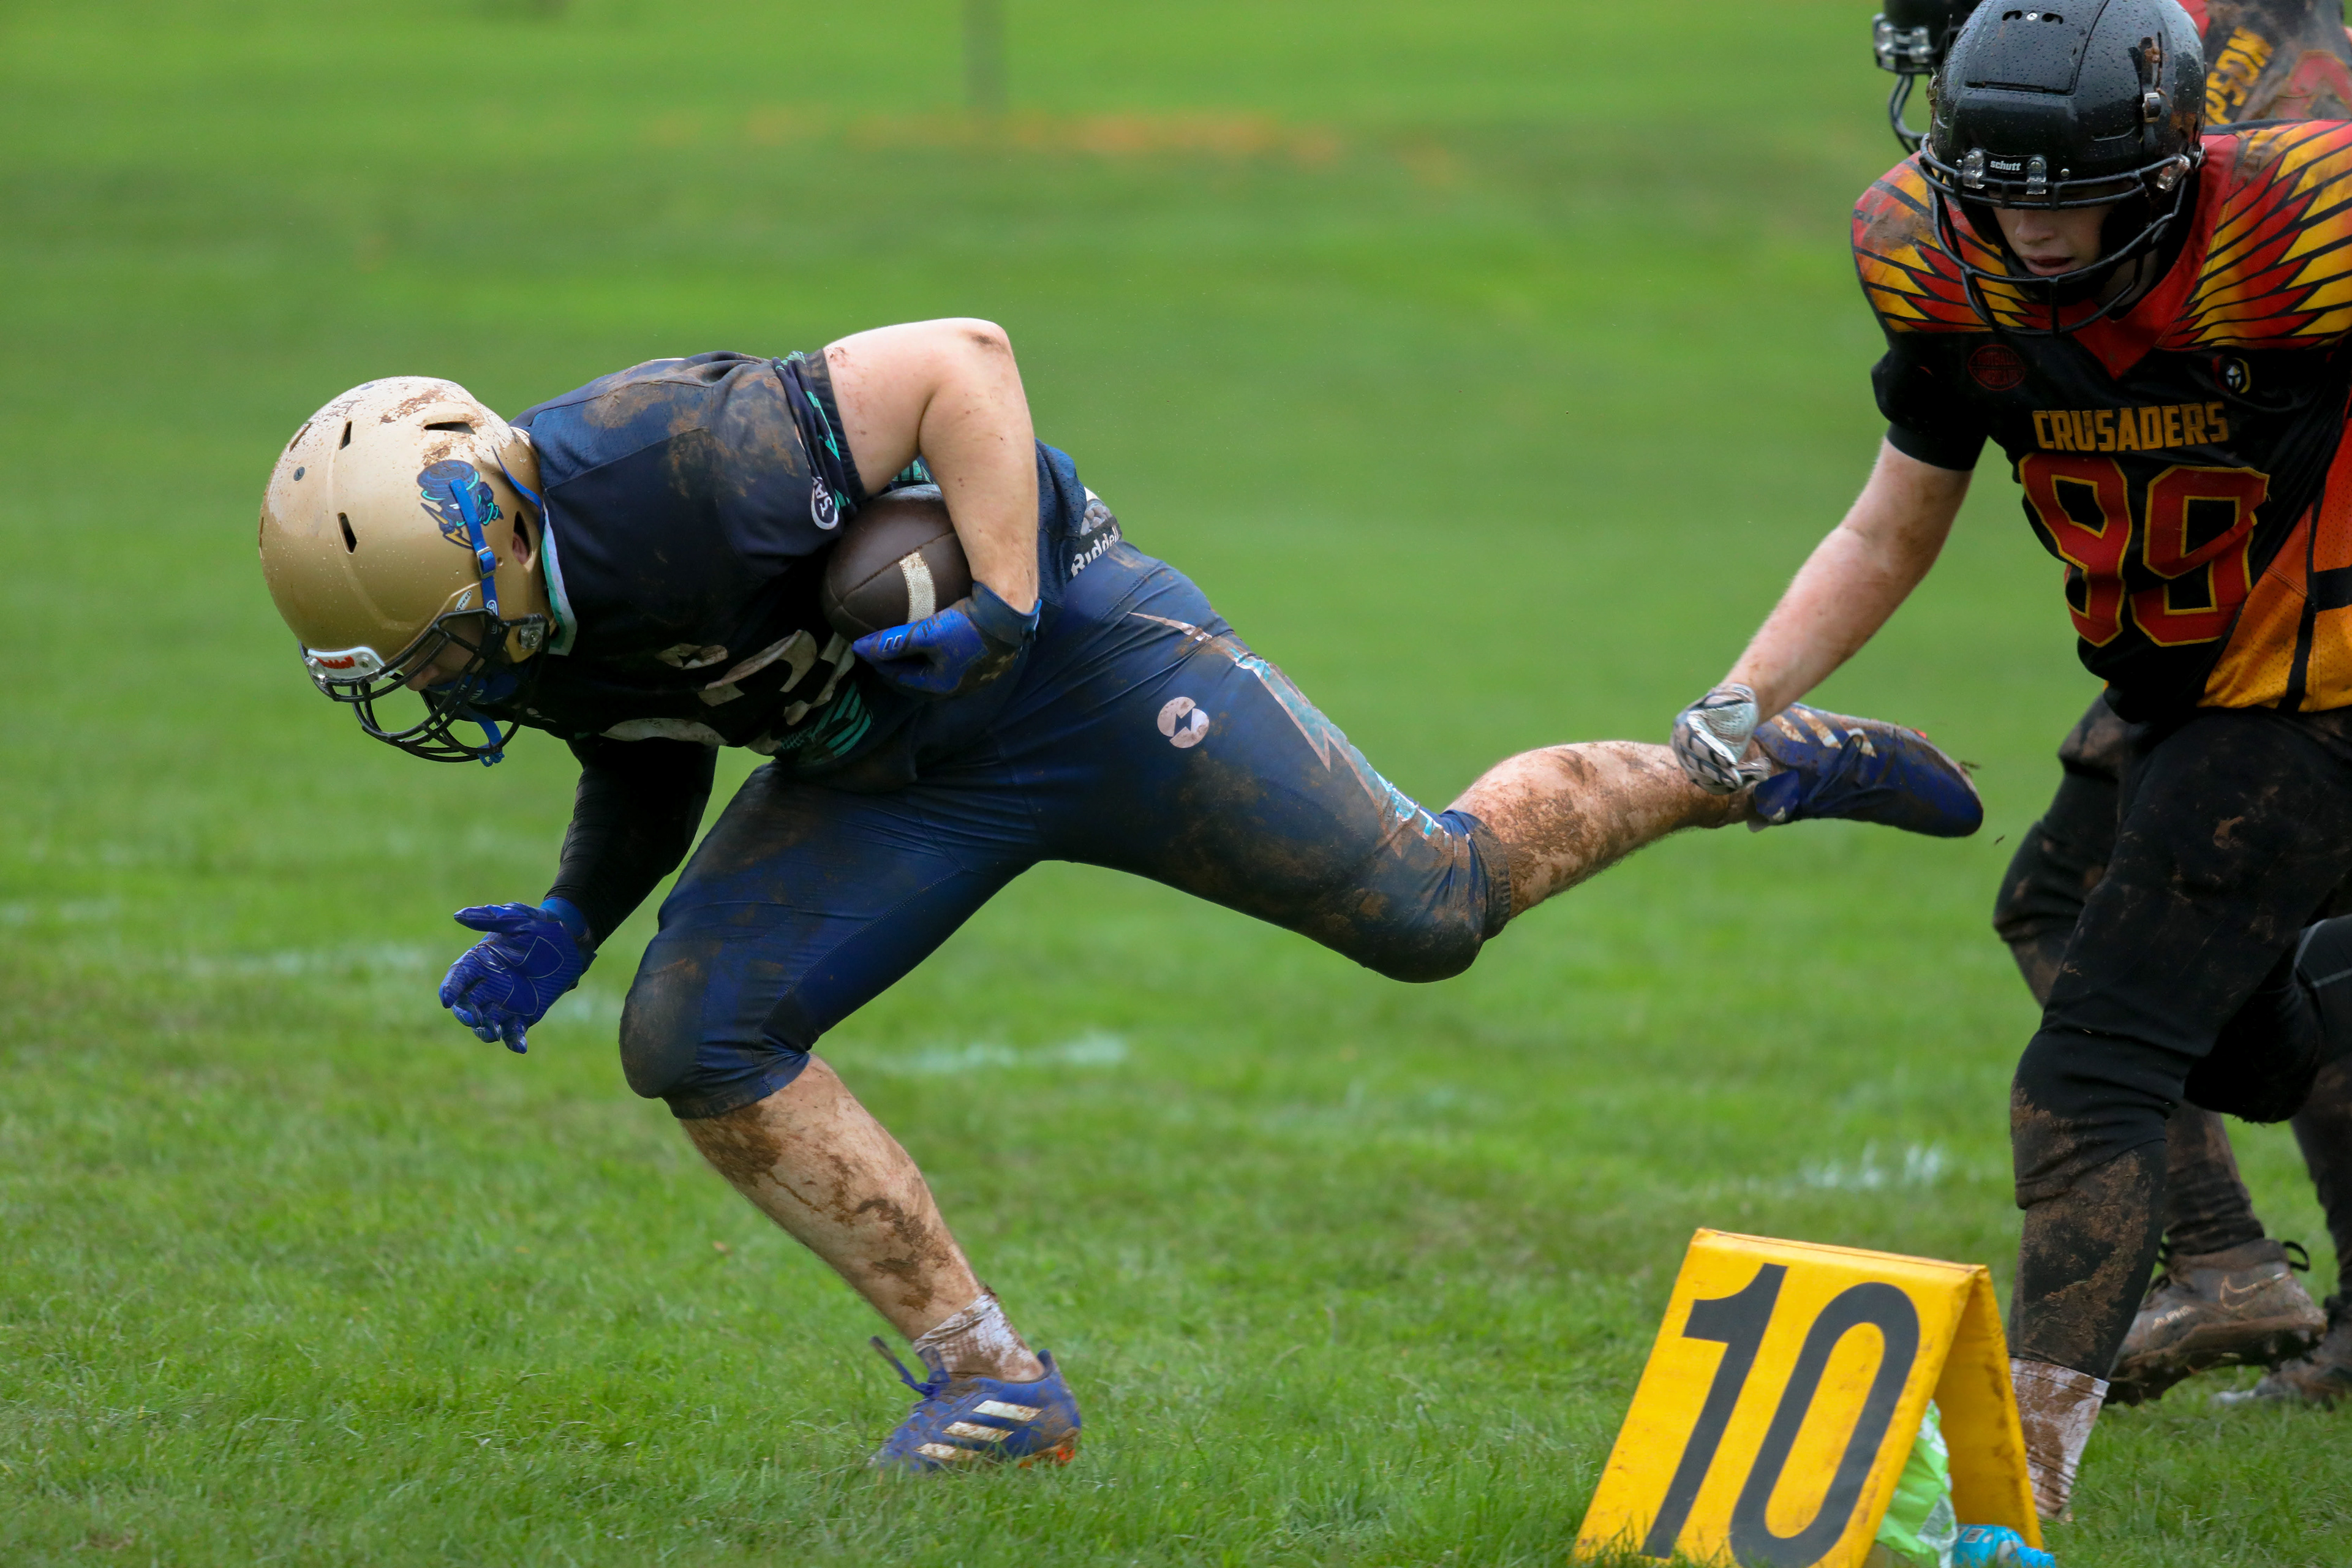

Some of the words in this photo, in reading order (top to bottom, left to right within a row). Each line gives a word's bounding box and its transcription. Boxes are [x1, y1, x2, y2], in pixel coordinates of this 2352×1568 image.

[2204, 25, 2274, 126] PSON
[1989, 160, 2021, 171] schutt
[2032, 401, 2228, 452] CRUSADERS
[1071, 524, 1120, 578] Riddell
[2019, 452, 2270, 648] 99
[1639, 1262, 1920, 1567] 10
